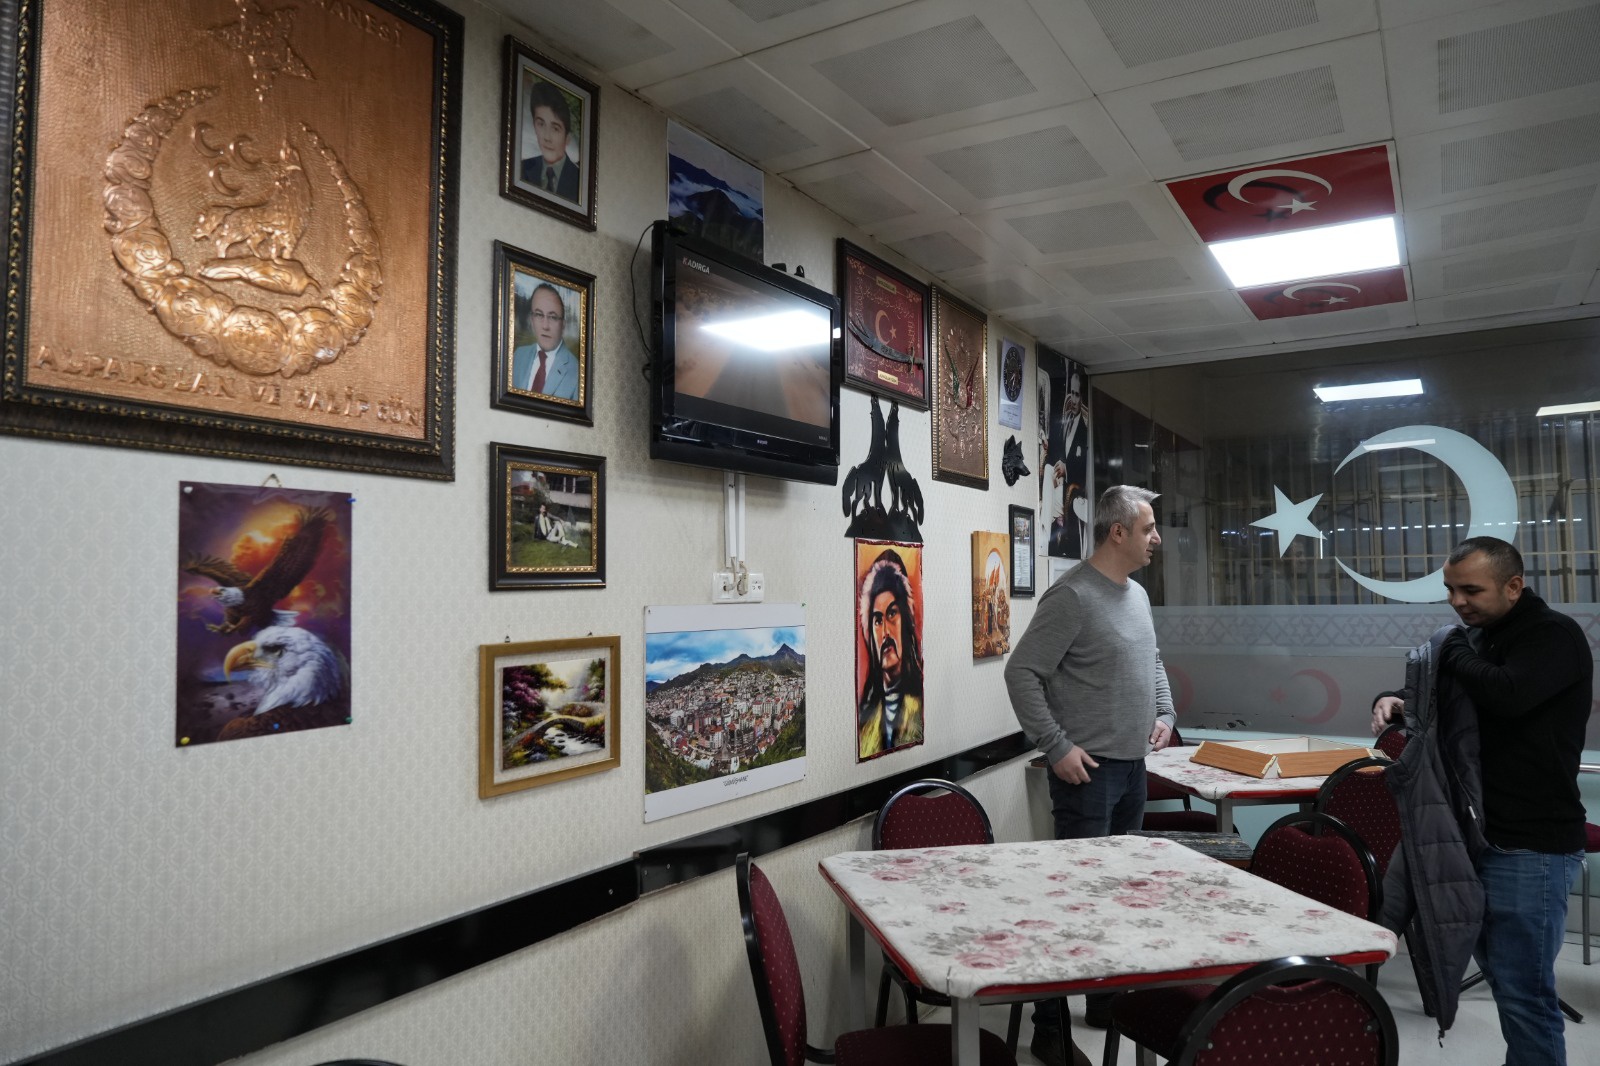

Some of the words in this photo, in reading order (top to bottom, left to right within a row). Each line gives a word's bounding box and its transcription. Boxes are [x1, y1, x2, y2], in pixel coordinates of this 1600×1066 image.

[309, 0, 402, 48] ANESİ
[682, 256, 710, 275] KADIRGA
[33, 345, 236, 398] ALPARSLAN
[247, 380, 282, 406] VE
